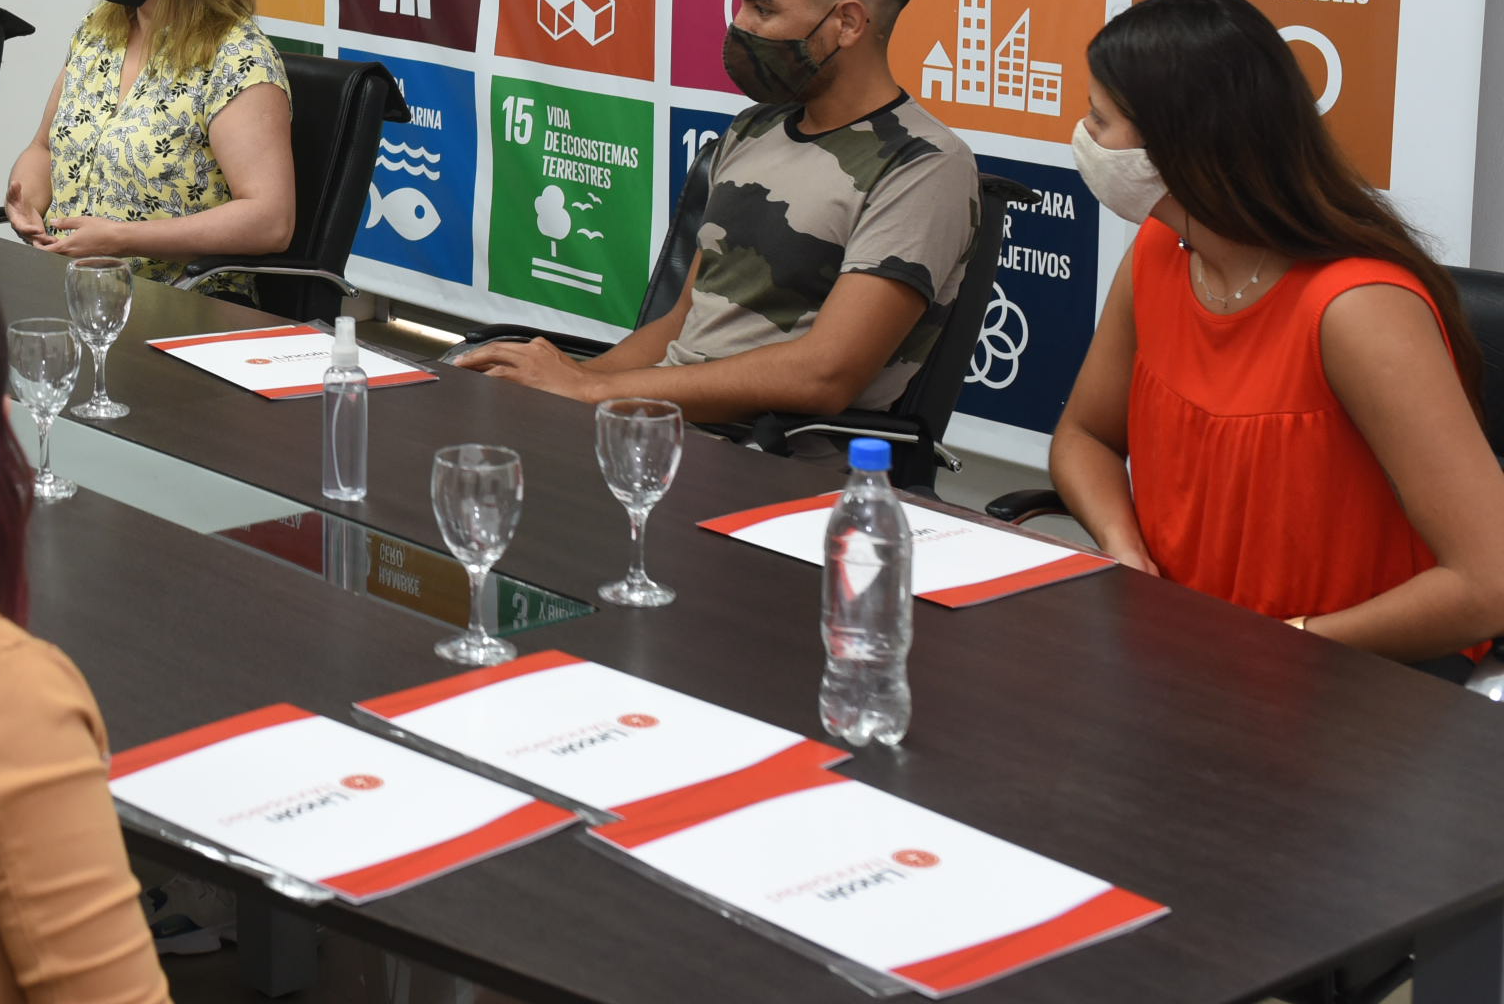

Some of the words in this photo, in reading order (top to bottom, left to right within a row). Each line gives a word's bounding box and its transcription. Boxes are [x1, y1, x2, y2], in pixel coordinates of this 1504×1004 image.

[407, 104, 442, 130] ARINA
[502, 95, 534, 145] 15
[546, 105, 571, 130] VIDA
[544, 130, 559, 152] DE
[561, 134, 639, 169] ECOSISTEMAS
[542, 155, 611, 189] TERRESTRES
[997, 244, 1071, 280] JETIVOS
